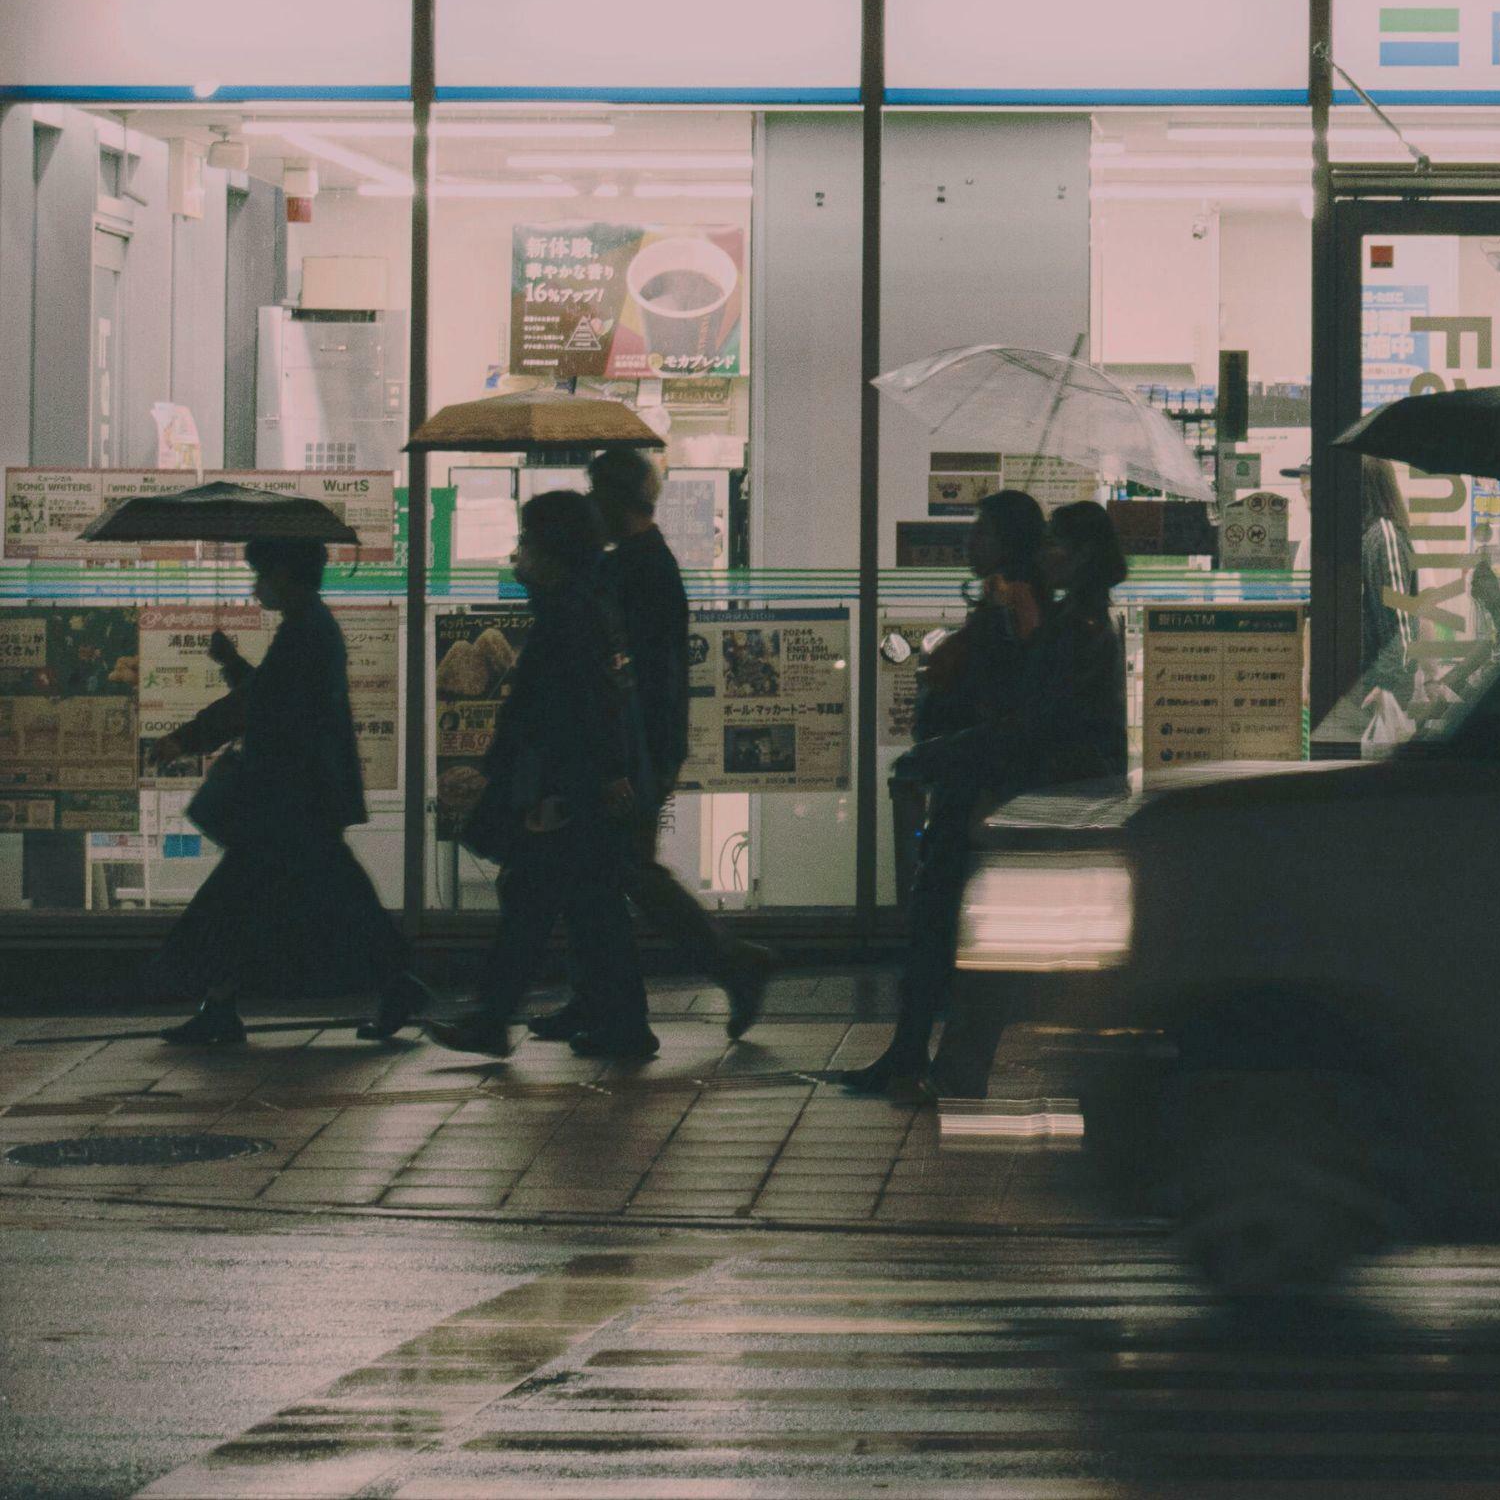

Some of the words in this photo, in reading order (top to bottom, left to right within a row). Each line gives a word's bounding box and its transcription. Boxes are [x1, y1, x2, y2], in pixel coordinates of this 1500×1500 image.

[664, 353, 736, 370] モカブレンド
[265, 481, 297, 491] HORN
[323, 479, 370, 492] WurtS
